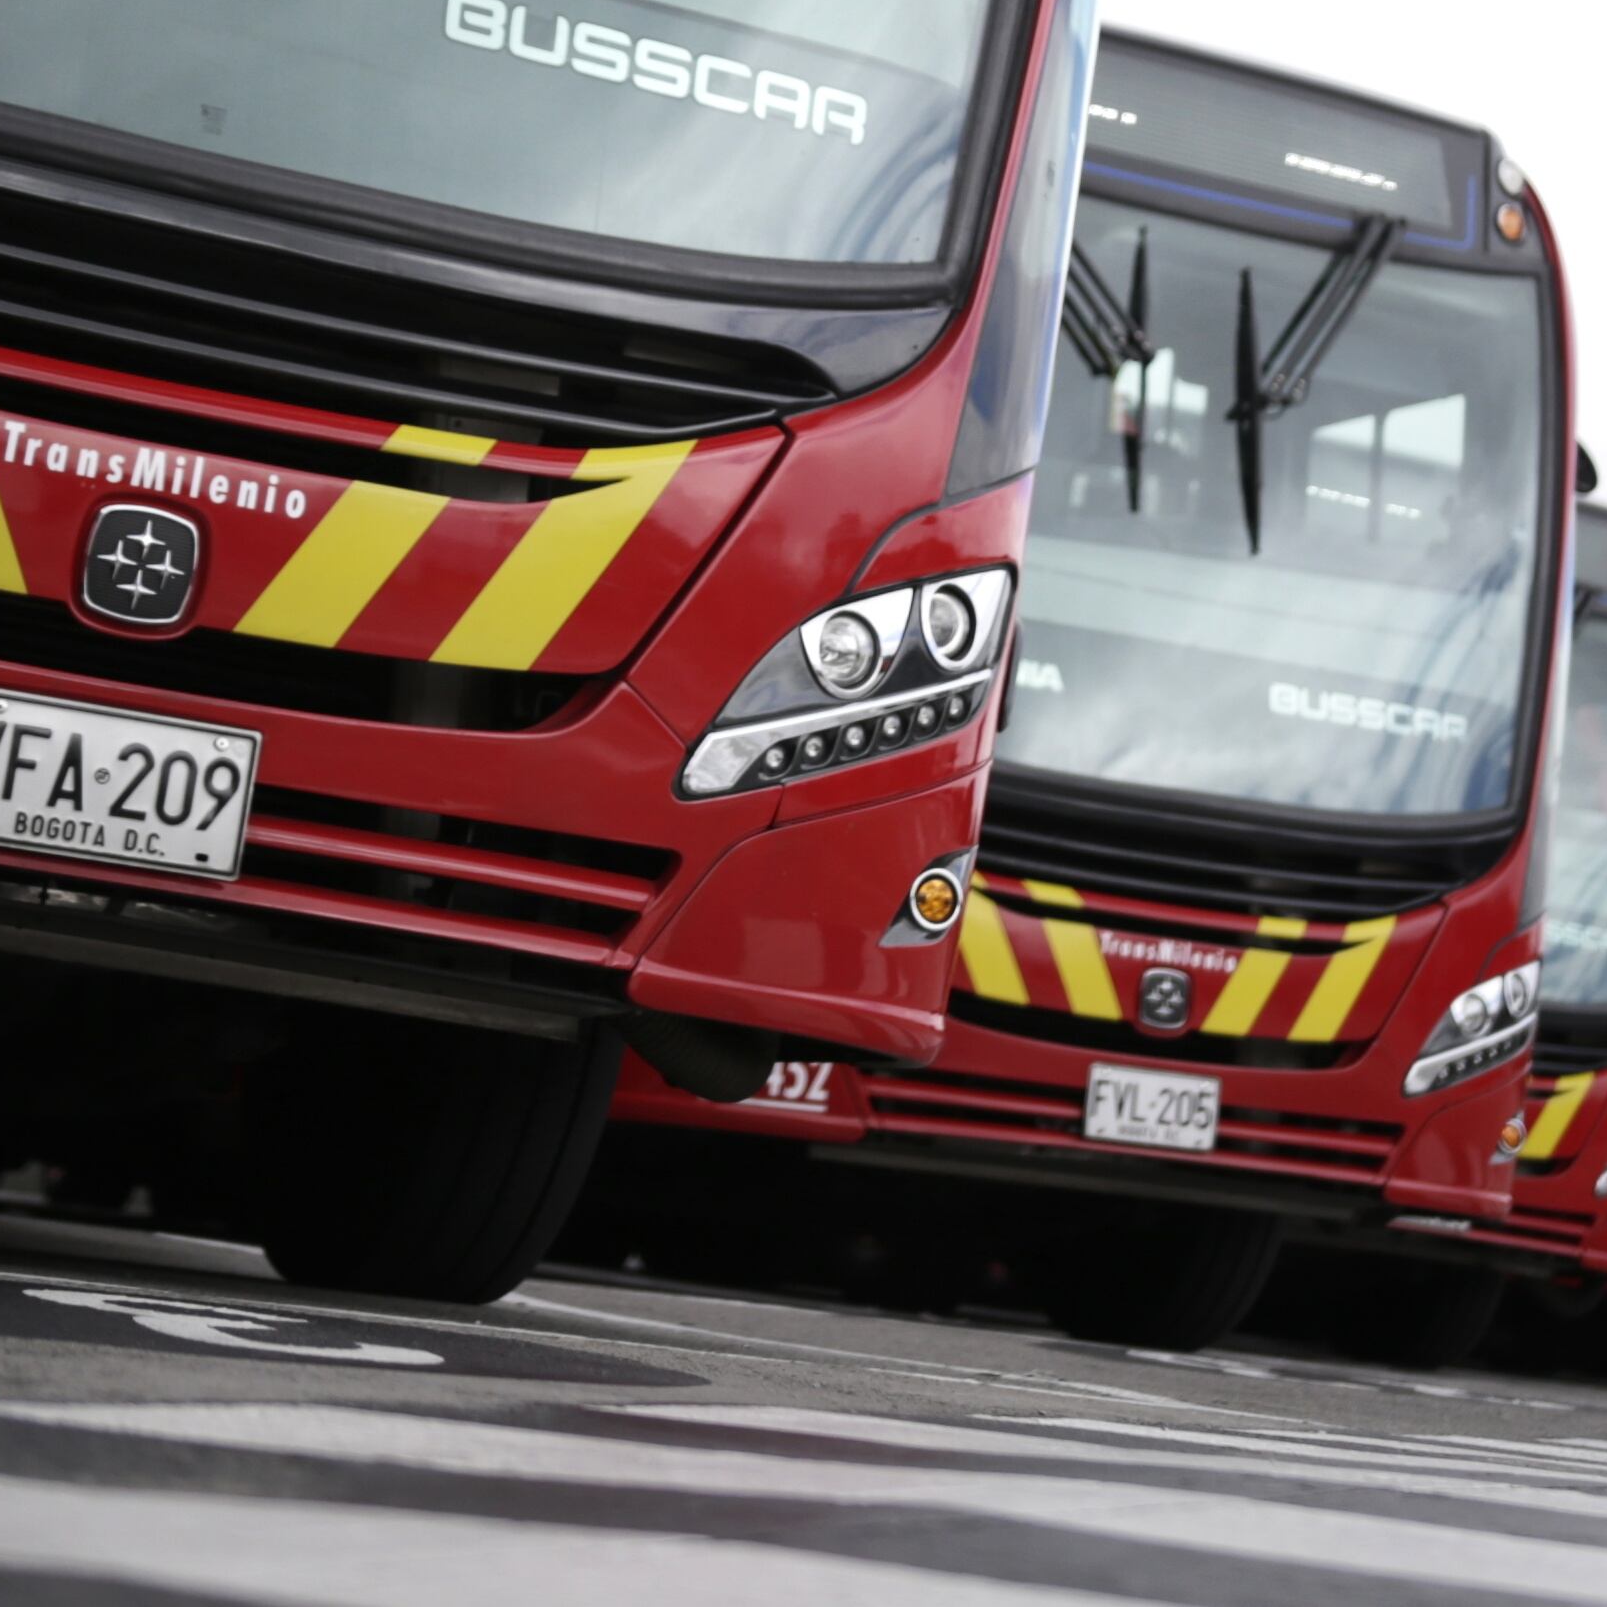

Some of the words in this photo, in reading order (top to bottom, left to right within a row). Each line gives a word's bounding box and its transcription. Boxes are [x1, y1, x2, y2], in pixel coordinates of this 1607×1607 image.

[3, 421, 308, 520] TransMilenio
[1268, 681, 1468, 741] BUSSCAR
[14, 811, 106, 847] BOGOTA
[123, 829, 165, 857] D.C.
